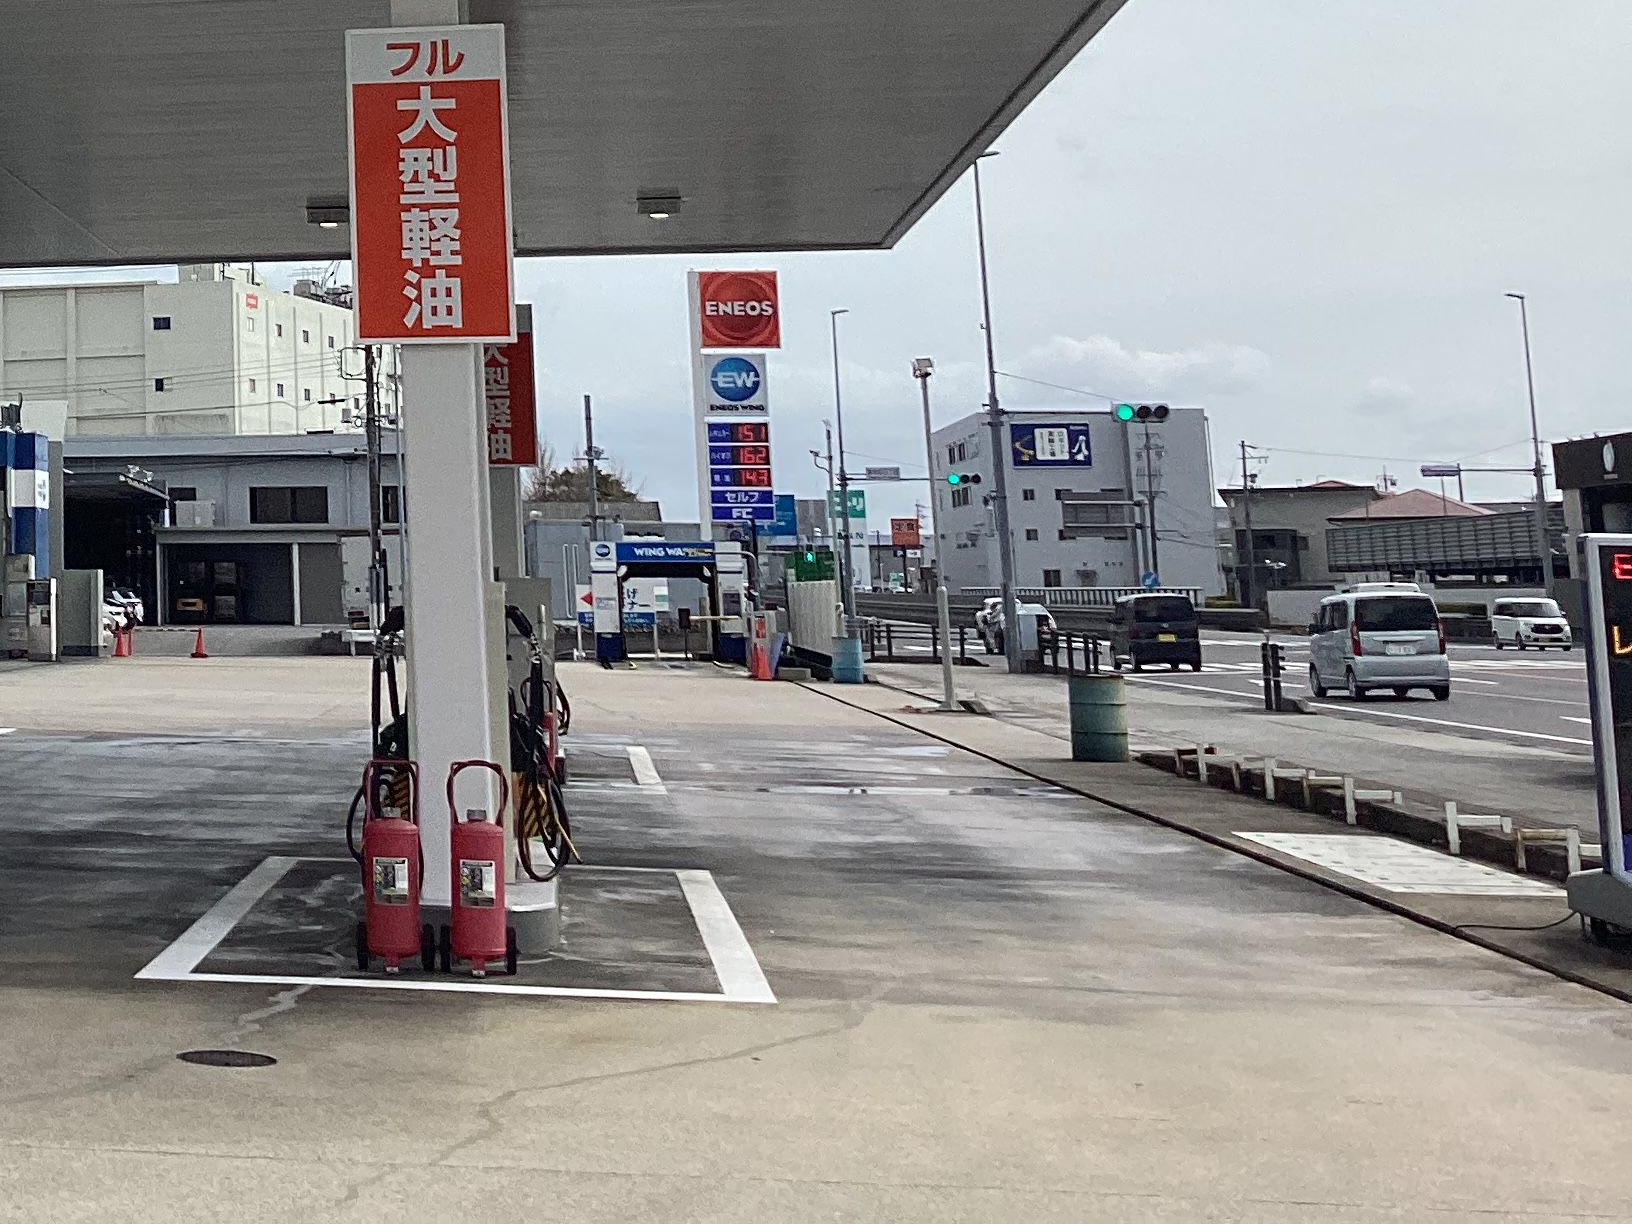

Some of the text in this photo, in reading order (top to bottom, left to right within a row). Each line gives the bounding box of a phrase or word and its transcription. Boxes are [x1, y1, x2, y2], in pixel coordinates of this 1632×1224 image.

[385, 38, 466, 77] フル
[395, 85, 464, 330] 大型軽油
[704, 300, 774, 316] ENEOS
[716, 371, 755, 388] EW
[738, 424, 766, 441] 151
[739, 446, 767, 464] 162
[741, 469, 769, 485] 143
[725, 491, 759, 503] セルフ
[732, 508, 753, 519] FC
[633, 547, 665, 557] WING
